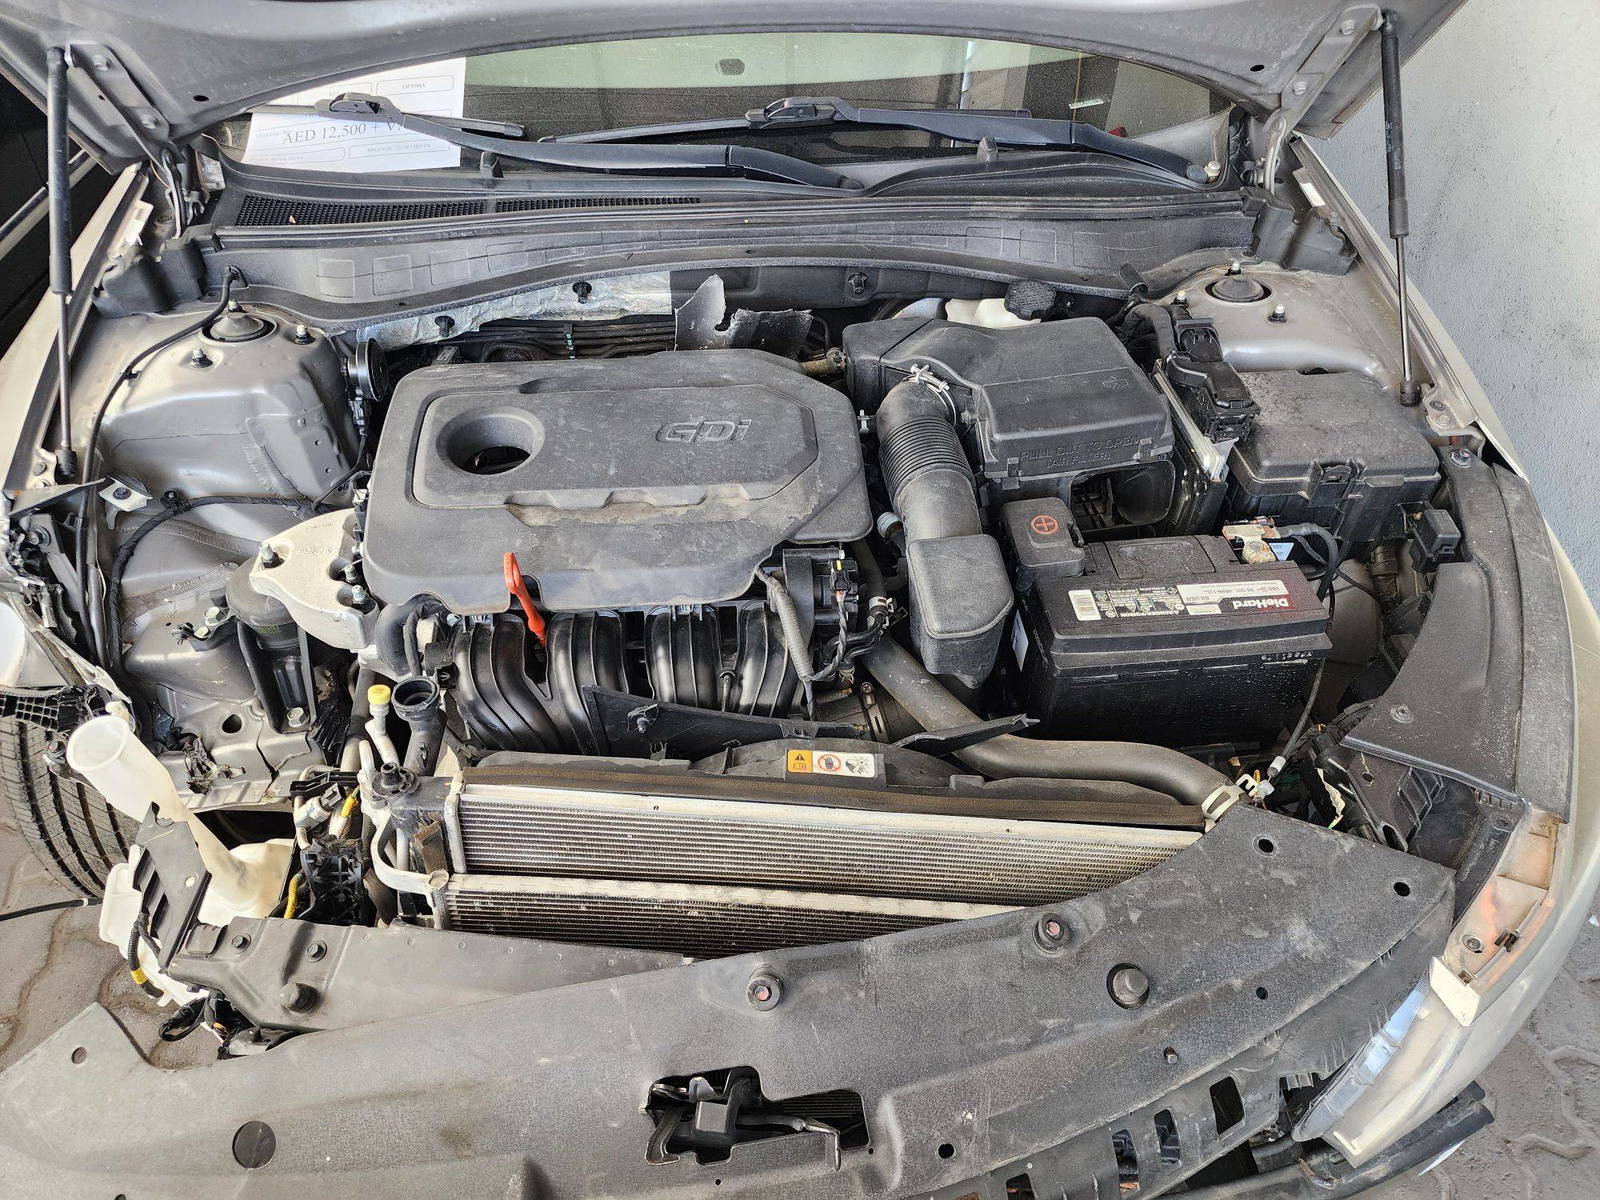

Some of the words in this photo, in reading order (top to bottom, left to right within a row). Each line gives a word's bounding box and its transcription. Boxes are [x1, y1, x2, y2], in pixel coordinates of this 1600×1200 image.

[282, 129, 316, 145] AED
[656, 419, 752, 442] GDi
[1021, 448, 1052, 460] PULL
[1056, 443, 1085, 456] OUT
[1086, 441, 1101, 451] TO
[1105, 435, 1139, 449] OPEN
[1232, 598, 1289, 609] DieHard
